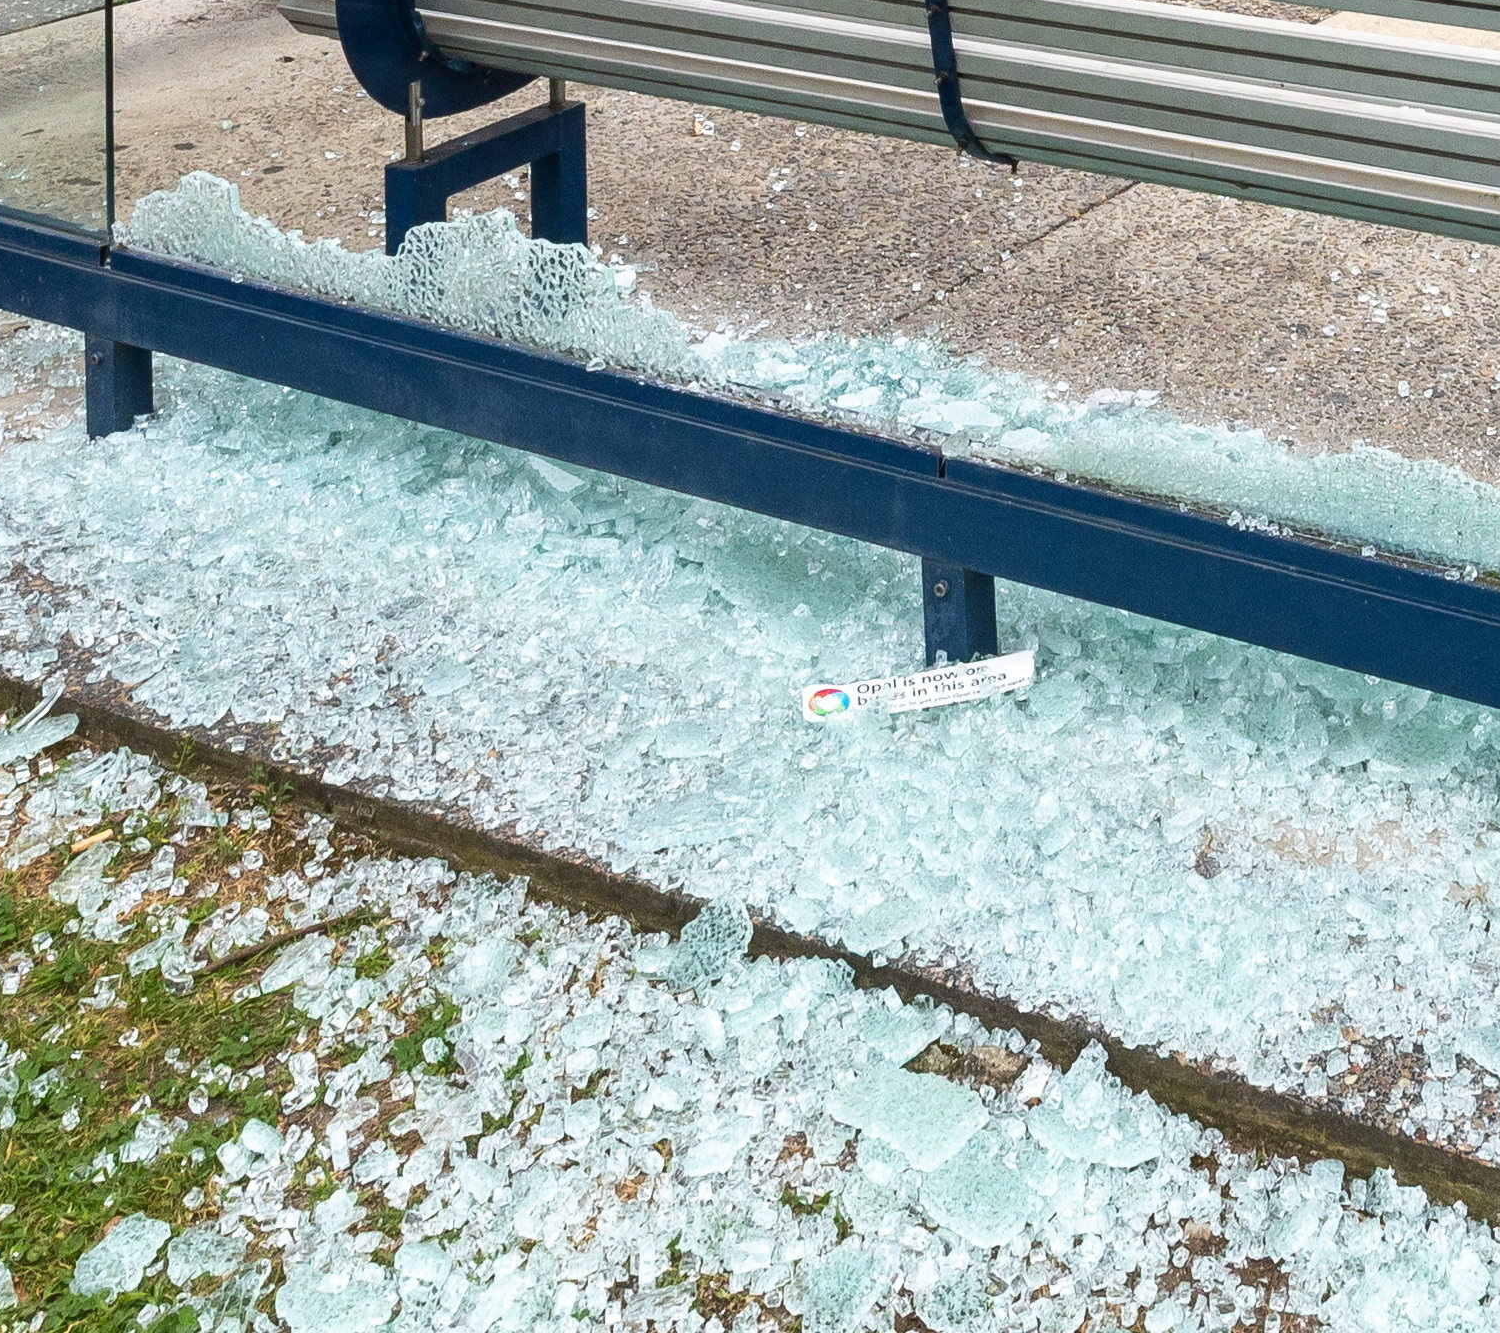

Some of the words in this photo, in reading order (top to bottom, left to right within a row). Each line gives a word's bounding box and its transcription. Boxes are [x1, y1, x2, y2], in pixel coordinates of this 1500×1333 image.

[903, 676, 916, 688] is
[921, 670, 958, 683] now
[912, 686, 927, 698] in
[934, 681, 966, 694] this
